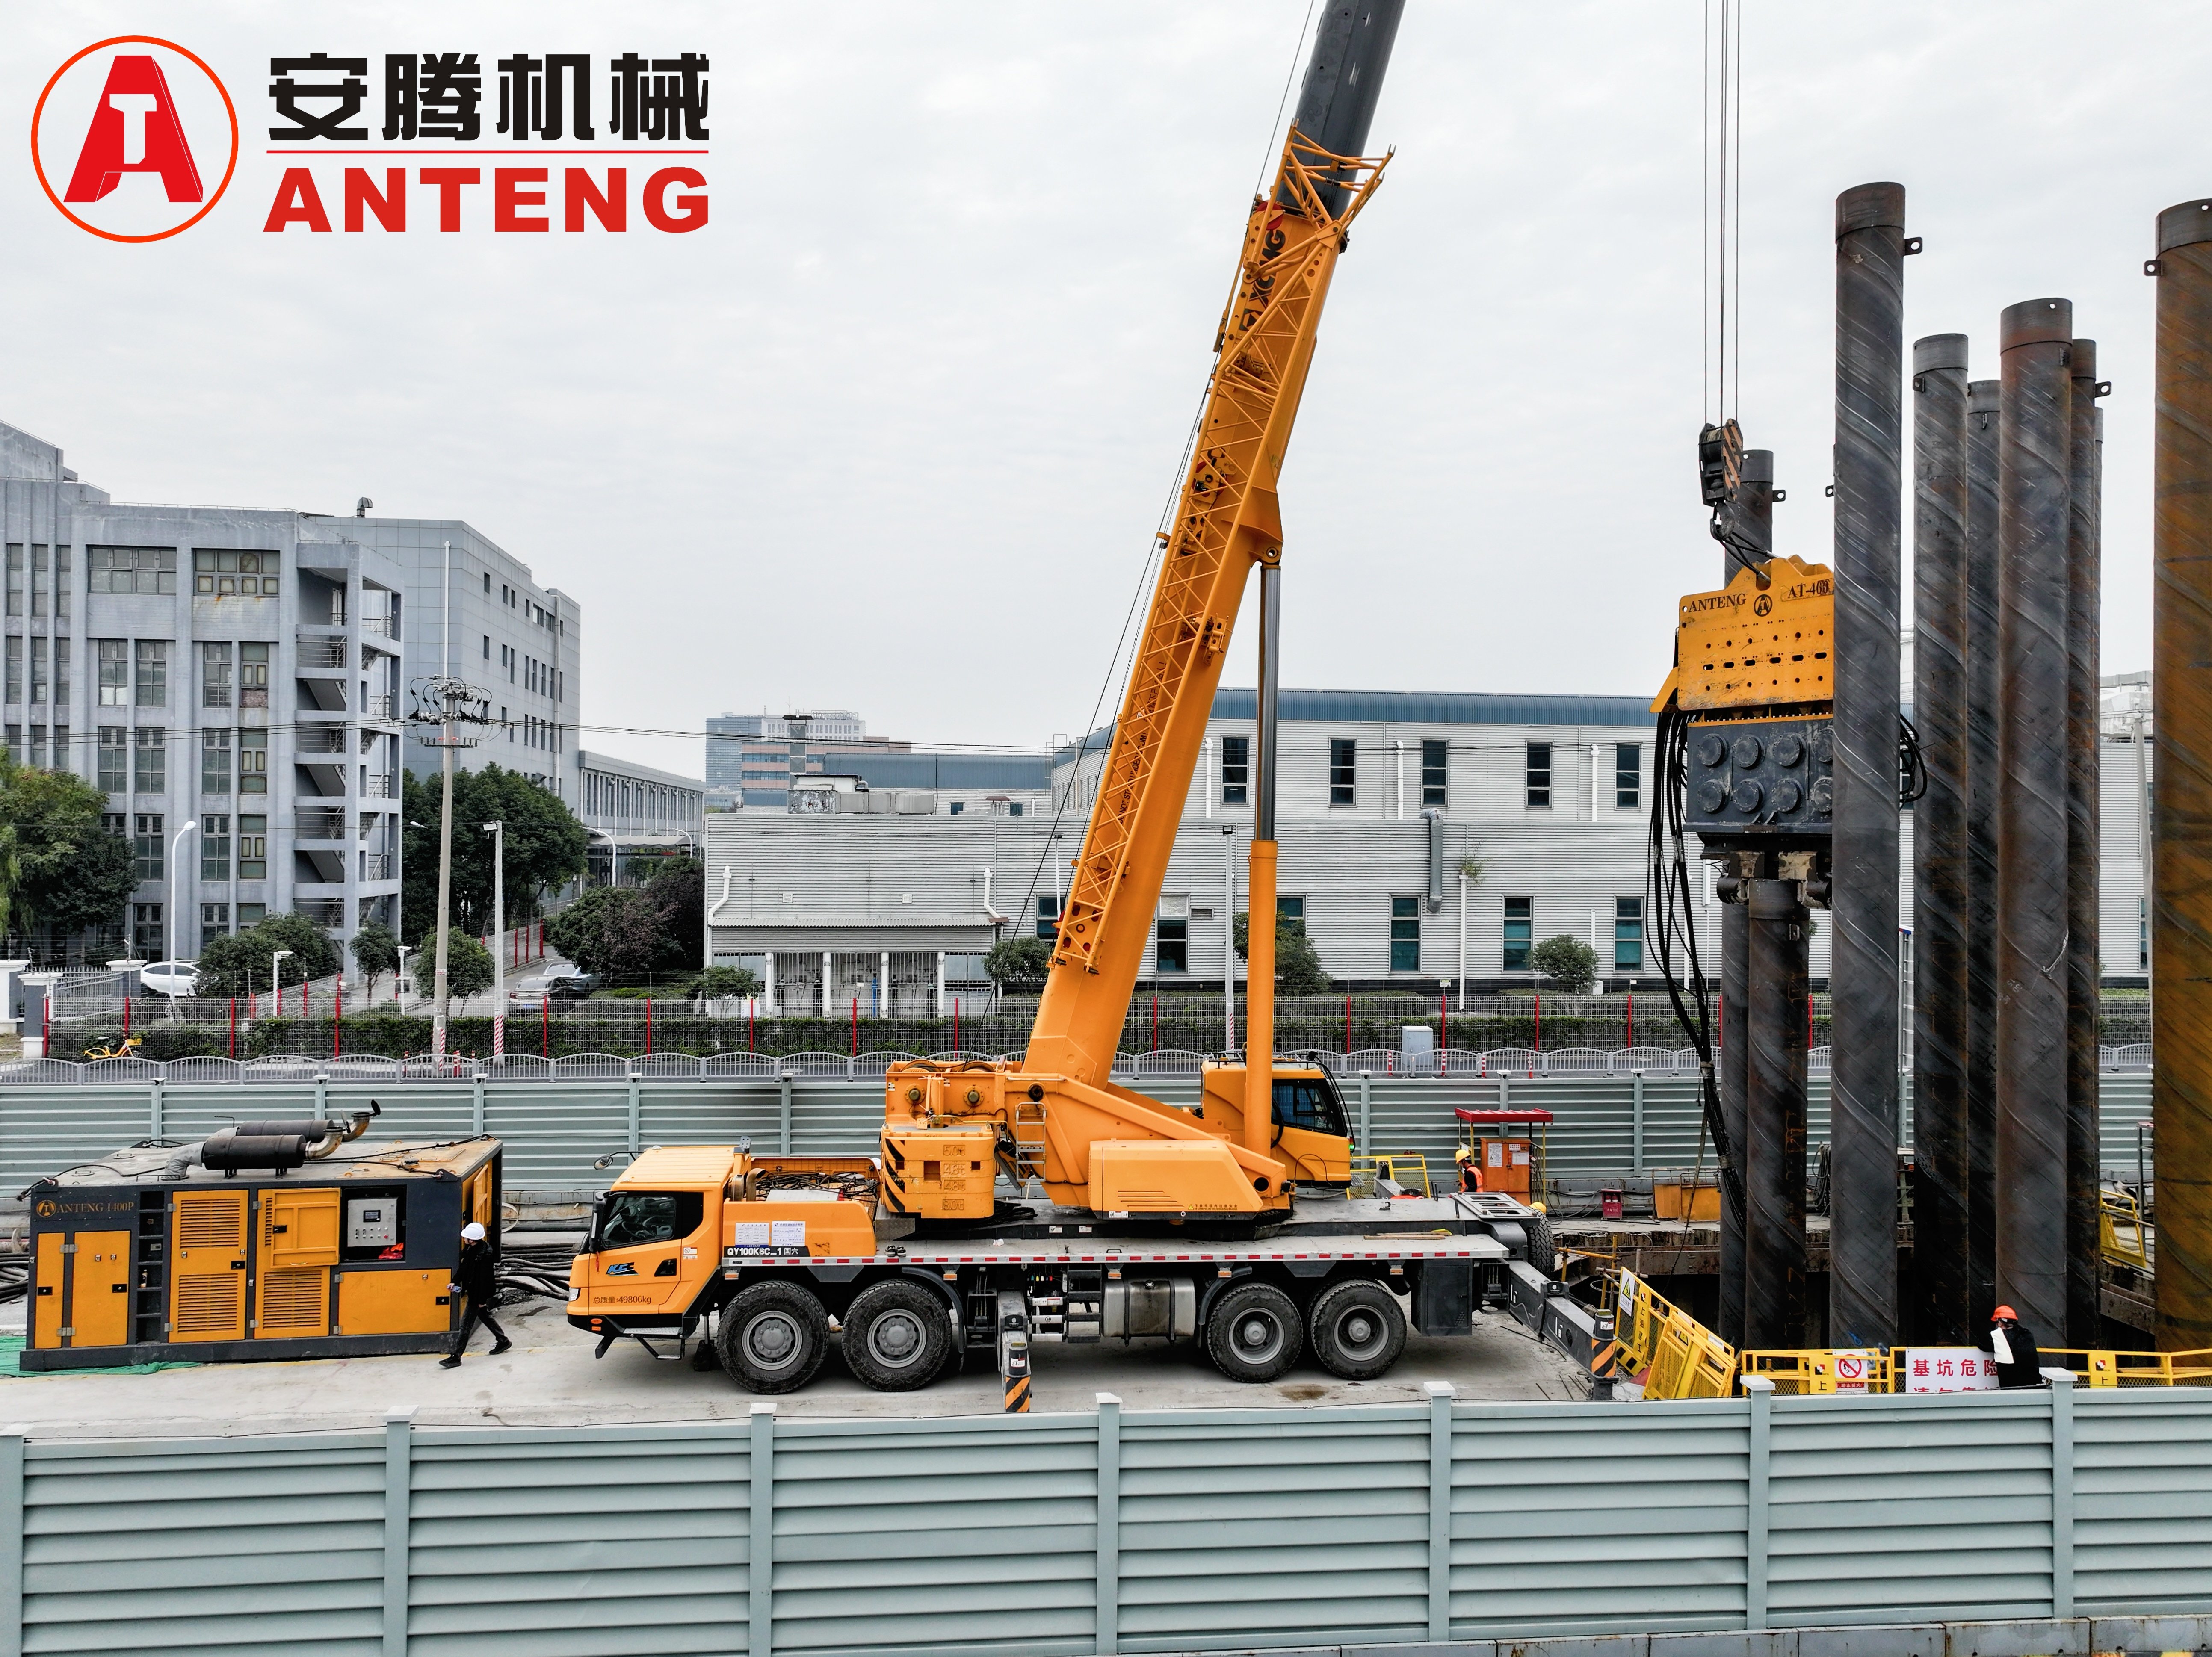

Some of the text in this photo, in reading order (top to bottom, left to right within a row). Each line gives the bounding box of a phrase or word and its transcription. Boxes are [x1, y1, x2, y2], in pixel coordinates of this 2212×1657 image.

[1689, 593, 1746, 612] ANTENG
[944, 1146, 965, 1156] 5.0t
[944, 1181, 965, 1191] 4.8t
[57, 1202, 134, 1213] ANTENG 1400P
[784, 1247, 798, 1255] 国六
[593, 1296, 651, 1304] 总质量:49800kg
[1913, 1359, 1998, 1376] 基坑危险
[1819, 1381, 1827, 1390] 上
